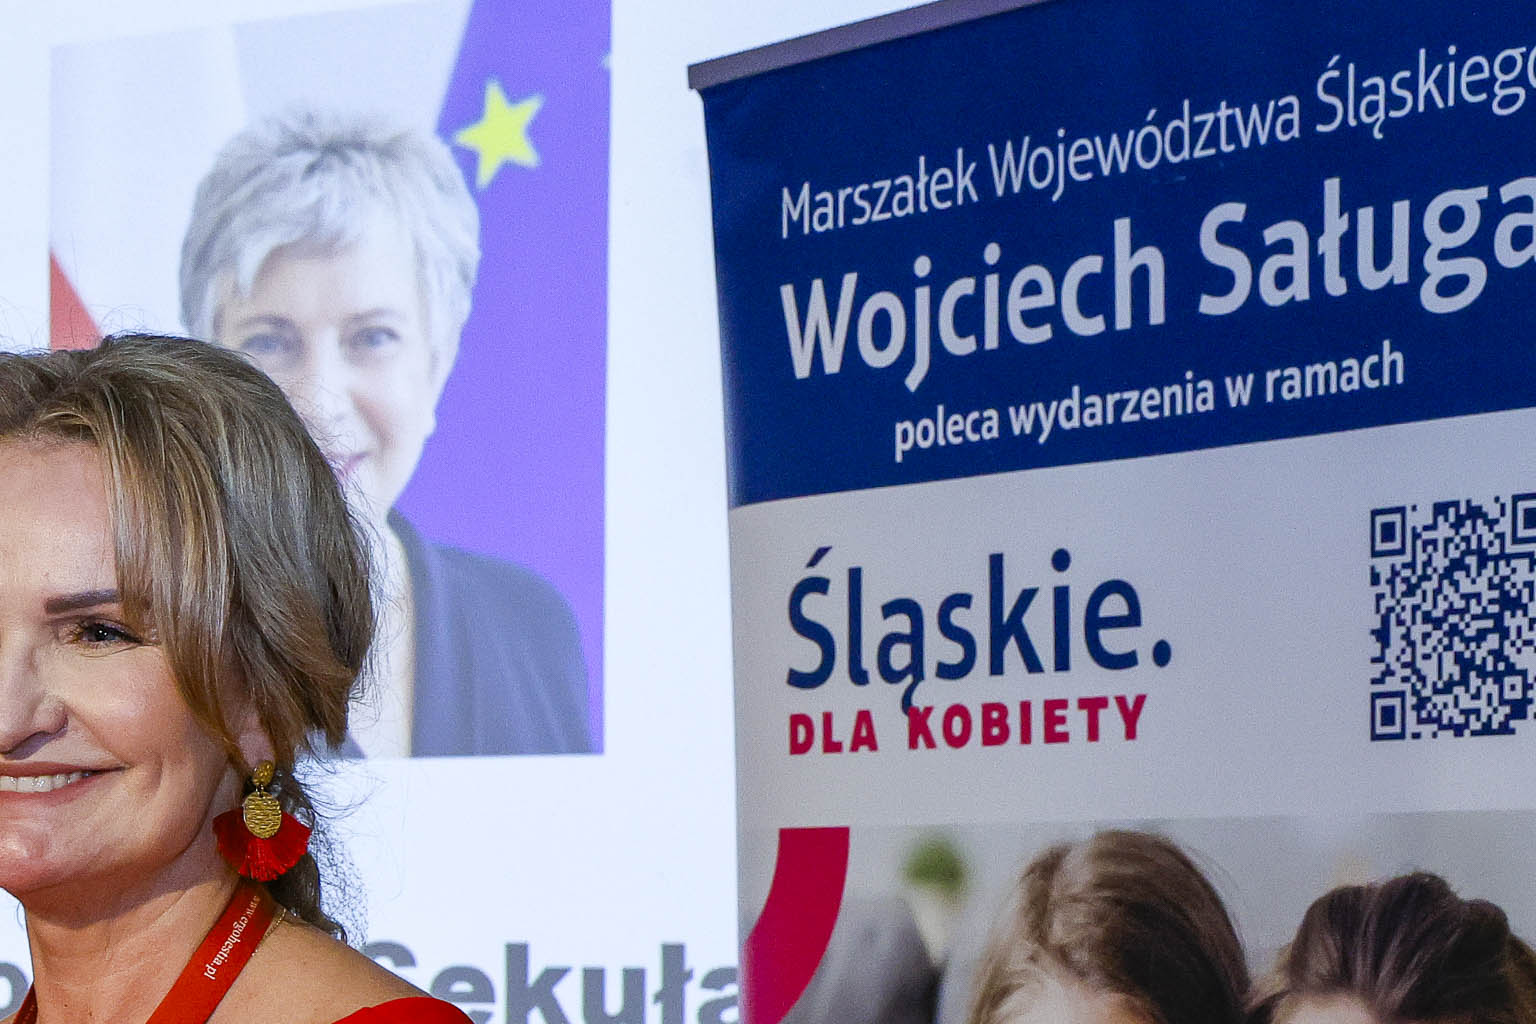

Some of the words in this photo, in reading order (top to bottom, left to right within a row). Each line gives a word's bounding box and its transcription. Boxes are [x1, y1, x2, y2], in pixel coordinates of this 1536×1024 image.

[781, 146, 979, 240] Marszałek
[987, 94, 1301, 202] Województwa
[779, 216, 1166, 393] Wojciech
[1198, 176, 1536, 316] Saługa
[894, 404, 1000, 463] poleca
[1009, 369, 1215, 445] wydarzenia
[1224, 370, 1255, 408] w
[1264, 339, 1405, 404] ramach
[786, 545, 1172, 717] Śląskie.
[789, 708, 879, 756] DLA
[907, 693, 1148, 751] KOBIETY
